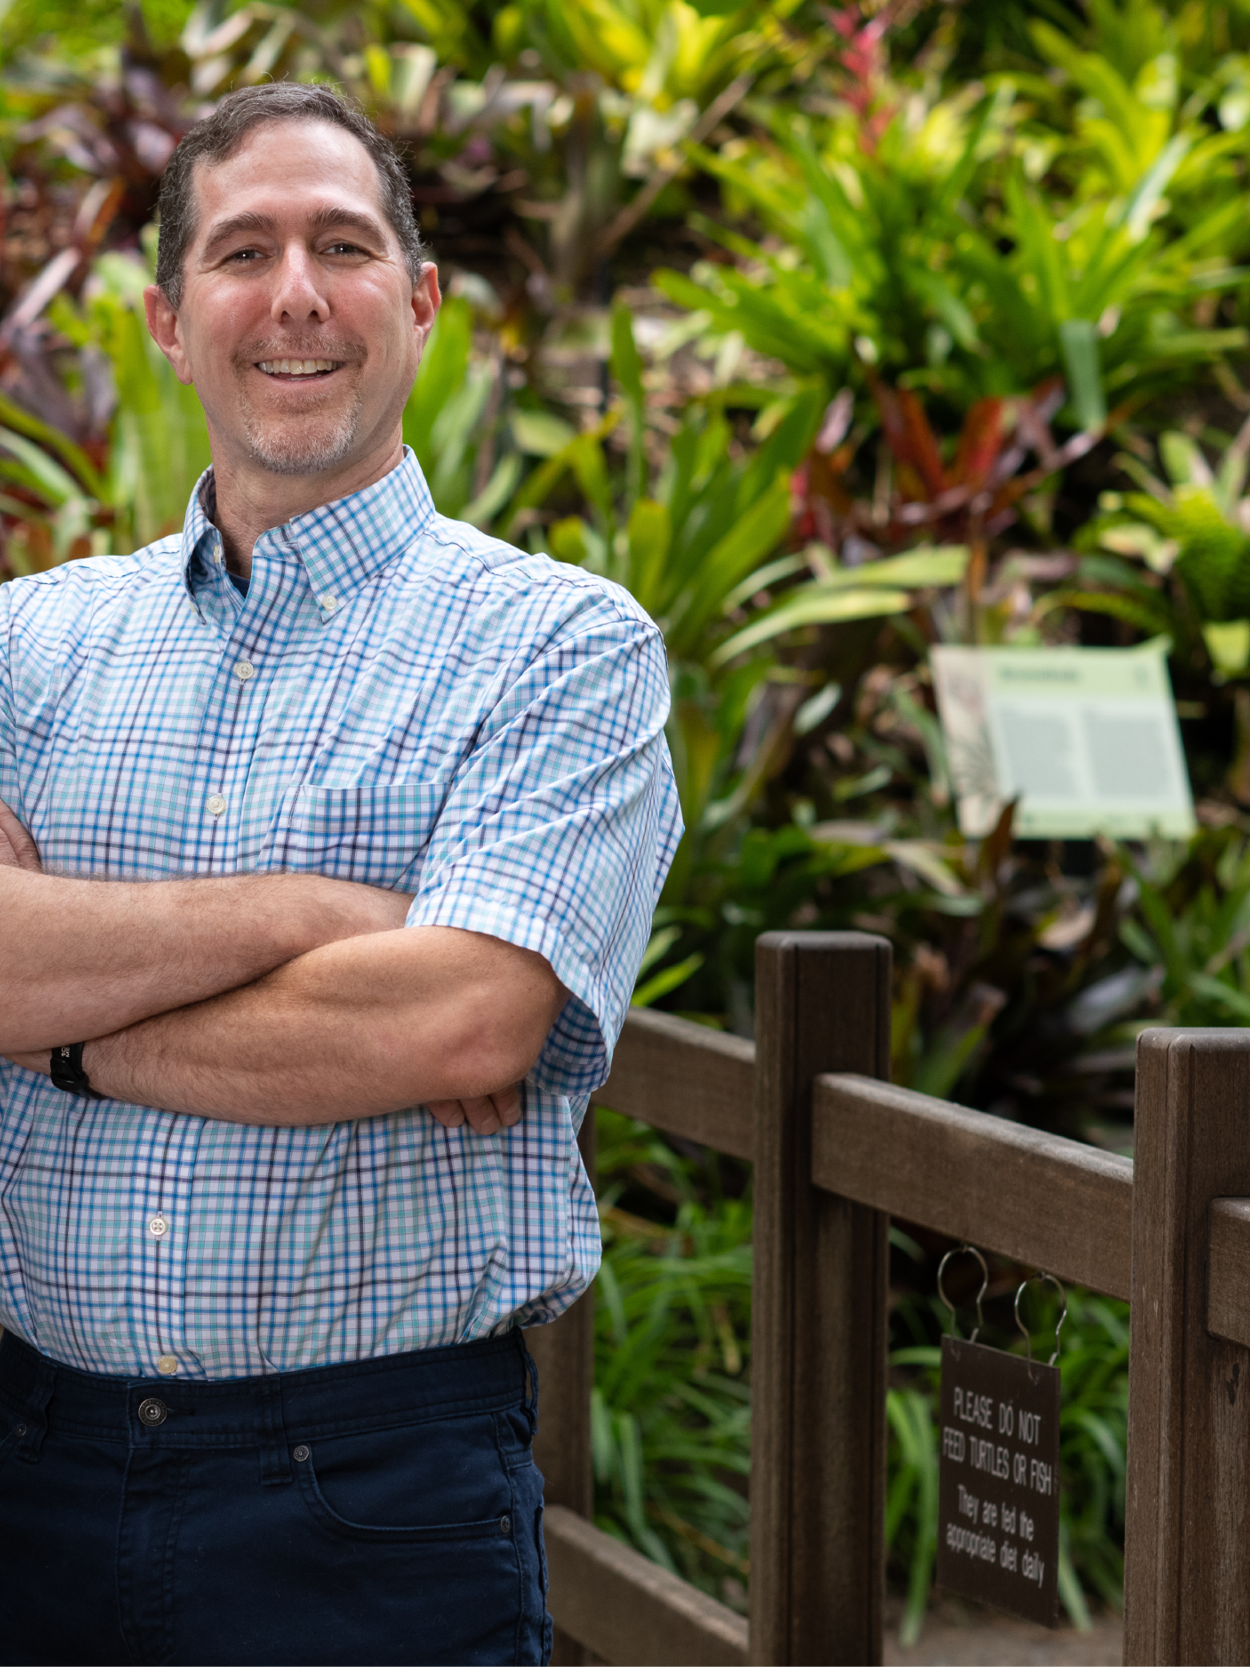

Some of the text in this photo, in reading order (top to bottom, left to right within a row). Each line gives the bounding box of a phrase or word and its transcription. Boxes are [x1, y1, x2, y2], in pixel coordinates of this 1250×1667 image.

[954, 1386, 1041, 1446] PLEASE DO NOT
[943, 1427, 1052, 1496] FEED TURTLES OR FISH
[957, 1484, 1034, 1541] They are fed the
[946, 1523, 1045, 1588] appropriate diet daily
